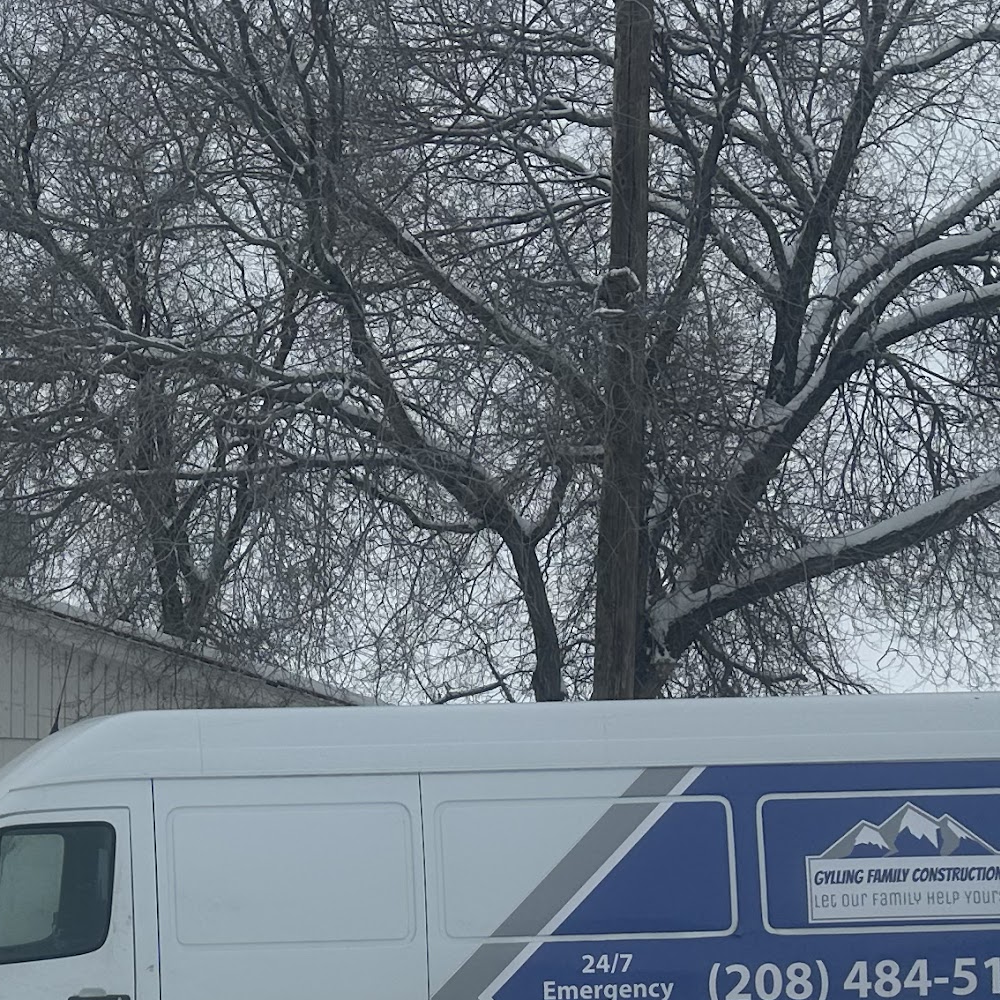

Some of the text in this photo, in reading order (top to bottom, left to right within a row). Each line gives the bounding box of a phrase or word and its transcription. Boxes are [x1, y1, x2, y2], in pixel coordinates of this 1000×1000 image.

[814, 869, 864, 885] GYLLING
[867, 867, 910, 883] FAMILY
[582, 953, 633, 974] 24/7
[843, 957, 1000, 998] 484-51
